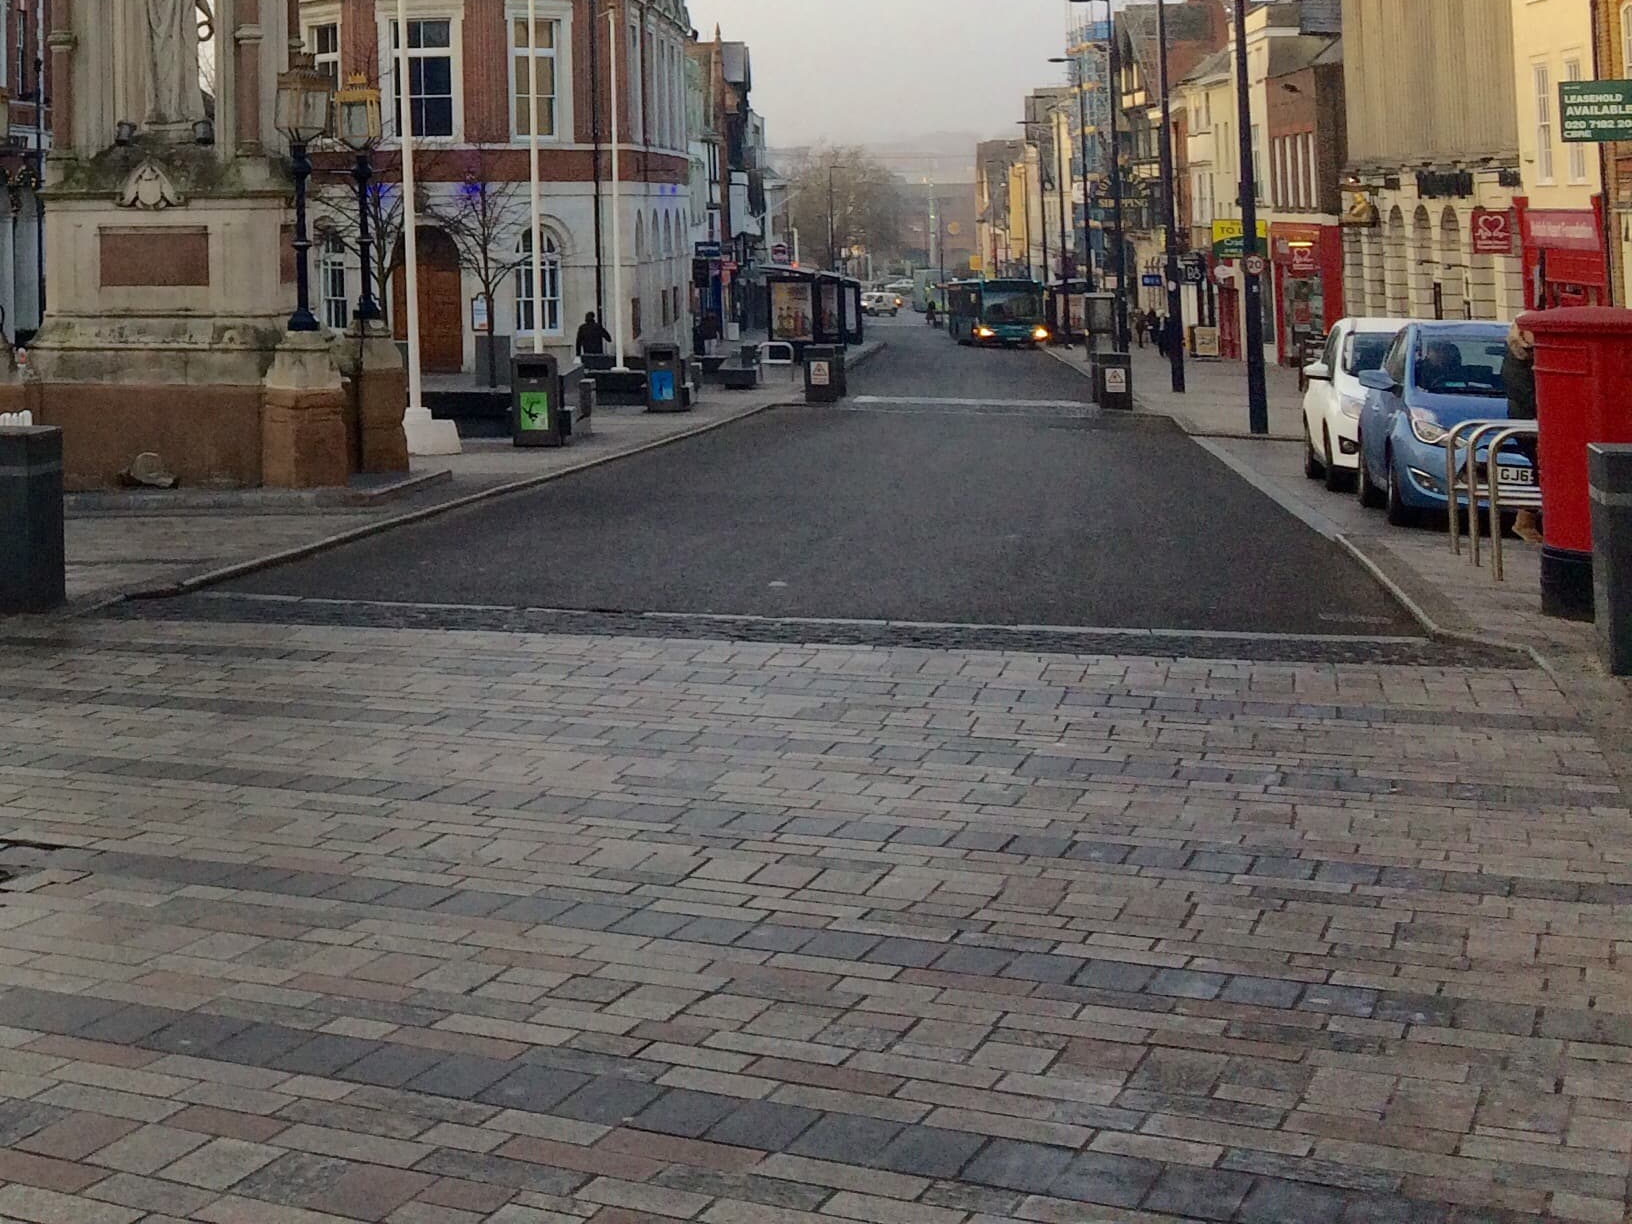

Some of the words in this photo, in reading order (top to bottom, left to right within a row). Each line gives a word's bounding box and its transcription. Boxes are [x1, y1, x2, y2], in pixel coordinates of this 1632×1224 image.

[1564, 93, 1623, 104] LEASEHOLD
[1565, 120, 1587, 130] 020
[1098, 198, 1149, 209] SHPPING
[1247, 258, 1263, 270] 20
